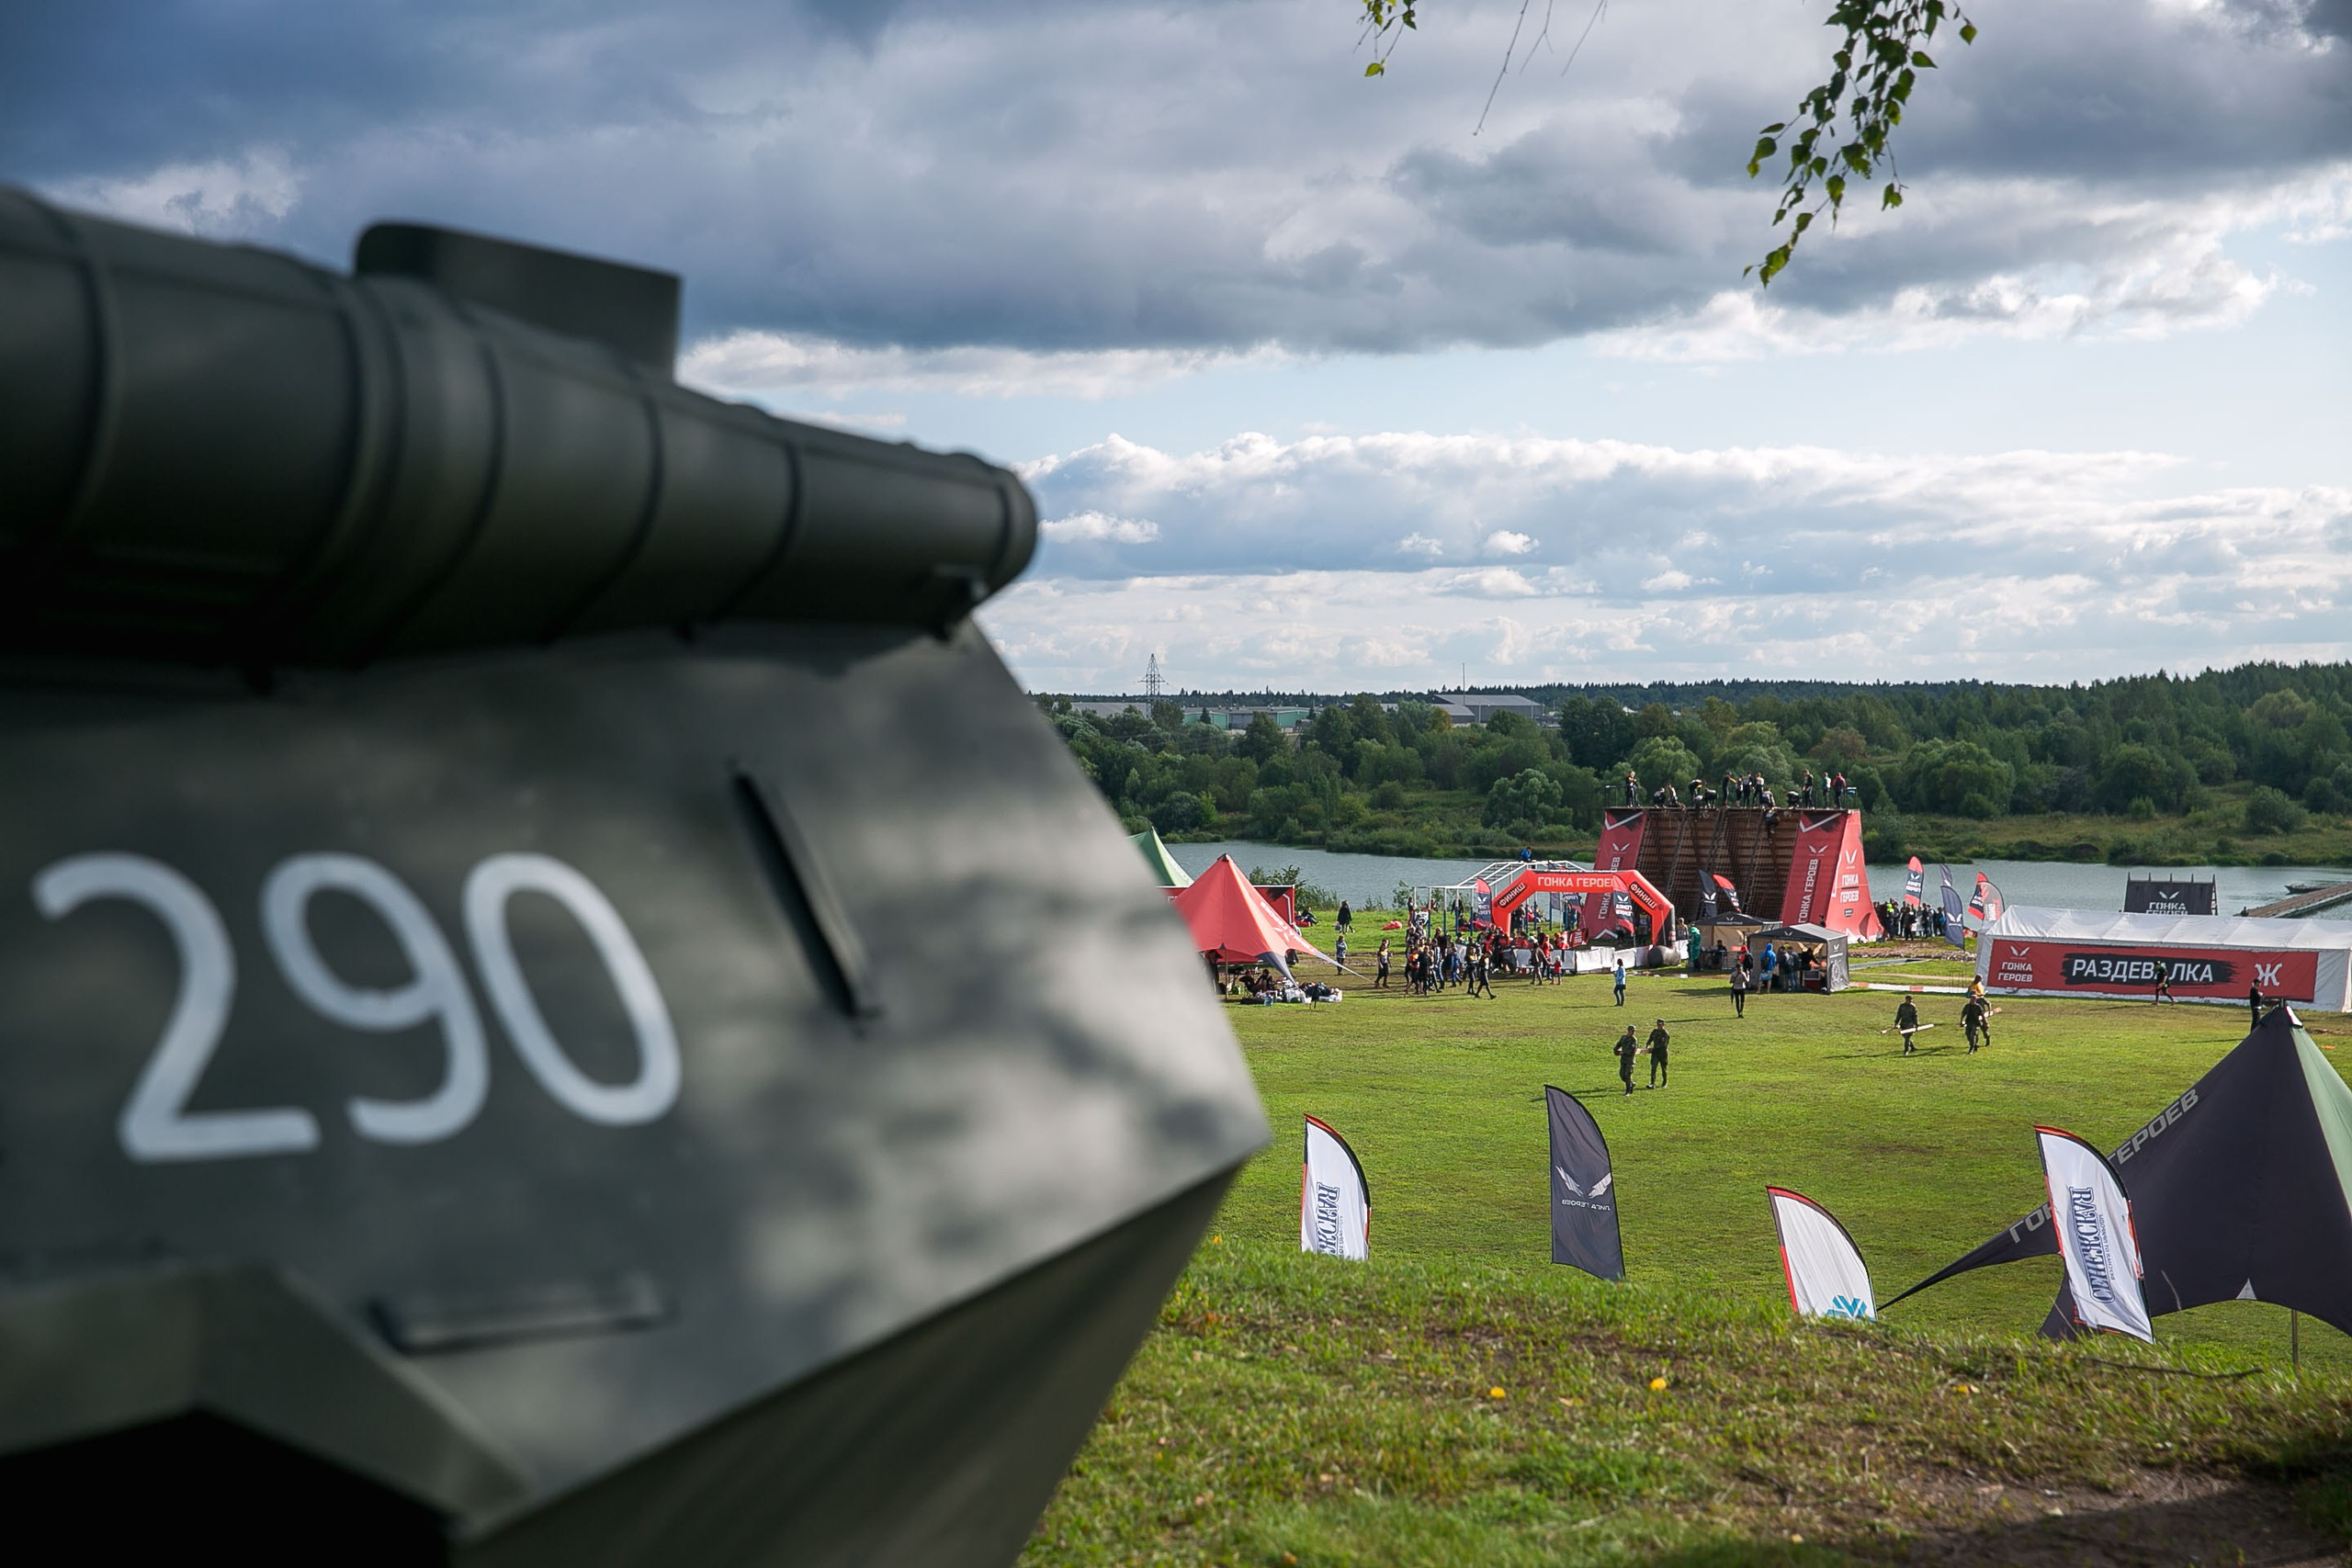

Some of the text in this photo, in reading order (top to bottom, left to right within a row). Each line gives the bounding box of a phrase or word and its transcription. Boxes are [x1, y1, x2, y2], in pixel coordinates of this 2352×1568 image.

[1537, 875, 1574, 888] ГОНКА
[1804, 859, 1818, 893] ГЕРОЕВ
[1841, 874, 1859, 886] ГОНКА
[1498, 882, 1527, 907] ФИНИШ
[1630, 883, 1657, 909] ФИНИШ
[1839, 890, 1860, 903] ГЕРОЕВ
[1798, 894, 1812, 923] ГОНКА
[2149, 902, 2187, 910] ГОНКА
[2001, 962, 2032, 972] ГОНКА
[2072, 958, 2283, 987] РАЗДЕВЛКА Ж
[1997, 972, 2033, 982] ГЕРОЕВ
[32, 851, 682, 1163] 290
